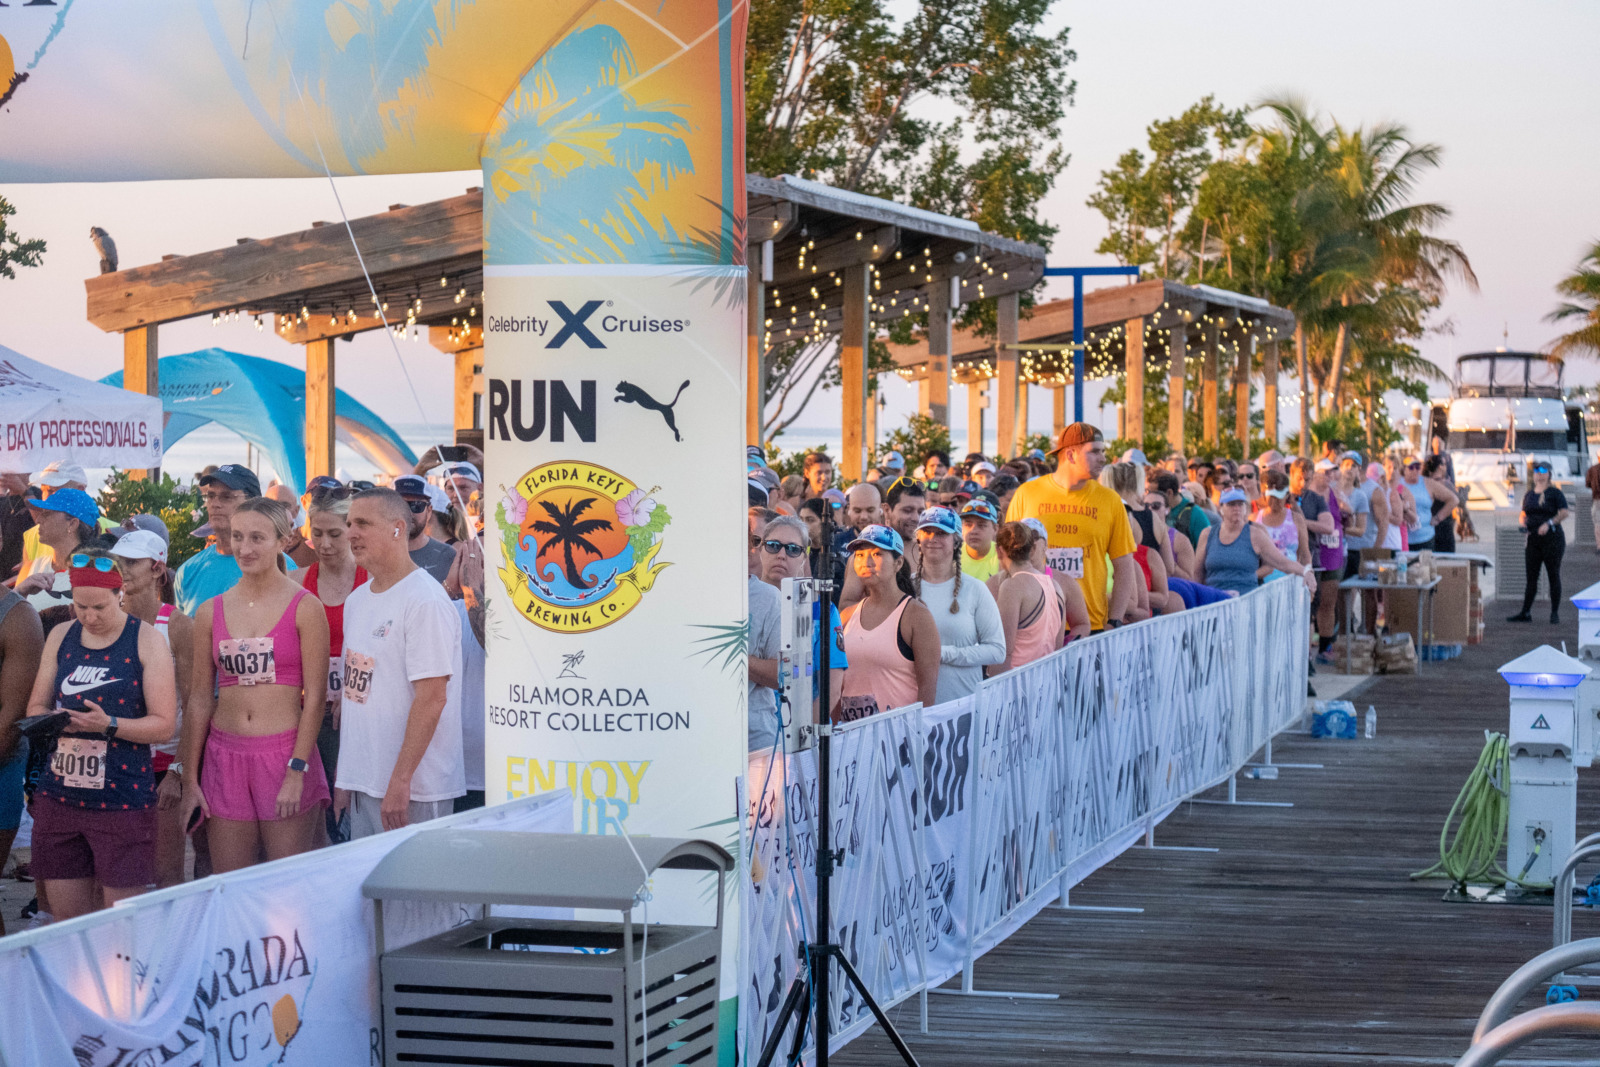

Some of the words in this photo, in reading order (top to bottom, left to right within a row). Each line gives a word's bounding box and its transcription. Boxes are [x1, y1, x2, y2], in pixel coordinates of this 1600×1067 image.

[489, 316, 549, 336] Celebrity
[489, 378, 597, 443] RUN
[7, 422, 35, 451] DAY
[40, 419, 147, 449] PROFESSIONALS
[525, 467, 579, 494] FLORIDA
[587, 470, 624, 495] KEYS
[1038, 503, 1098, 520] CHAMINADE
[1055, 523, 1078, 534] 2019
[1050, 557, 1079, 572] 4371
[526, 600, 592, 625] BREWING
[69, 665, 110, 684] NIKE
[225, 652, 269, 675] 4037
[344, 663, 368, 692] 035
[509, 684, 650, 707] ISLAMORADA
[489, 705, 542, 730] RESORT
[547, 711, 691, 732] COLLECTION
[55, 752, 100, 777] 4019
[506, 756, 651, 805] ENJOY
